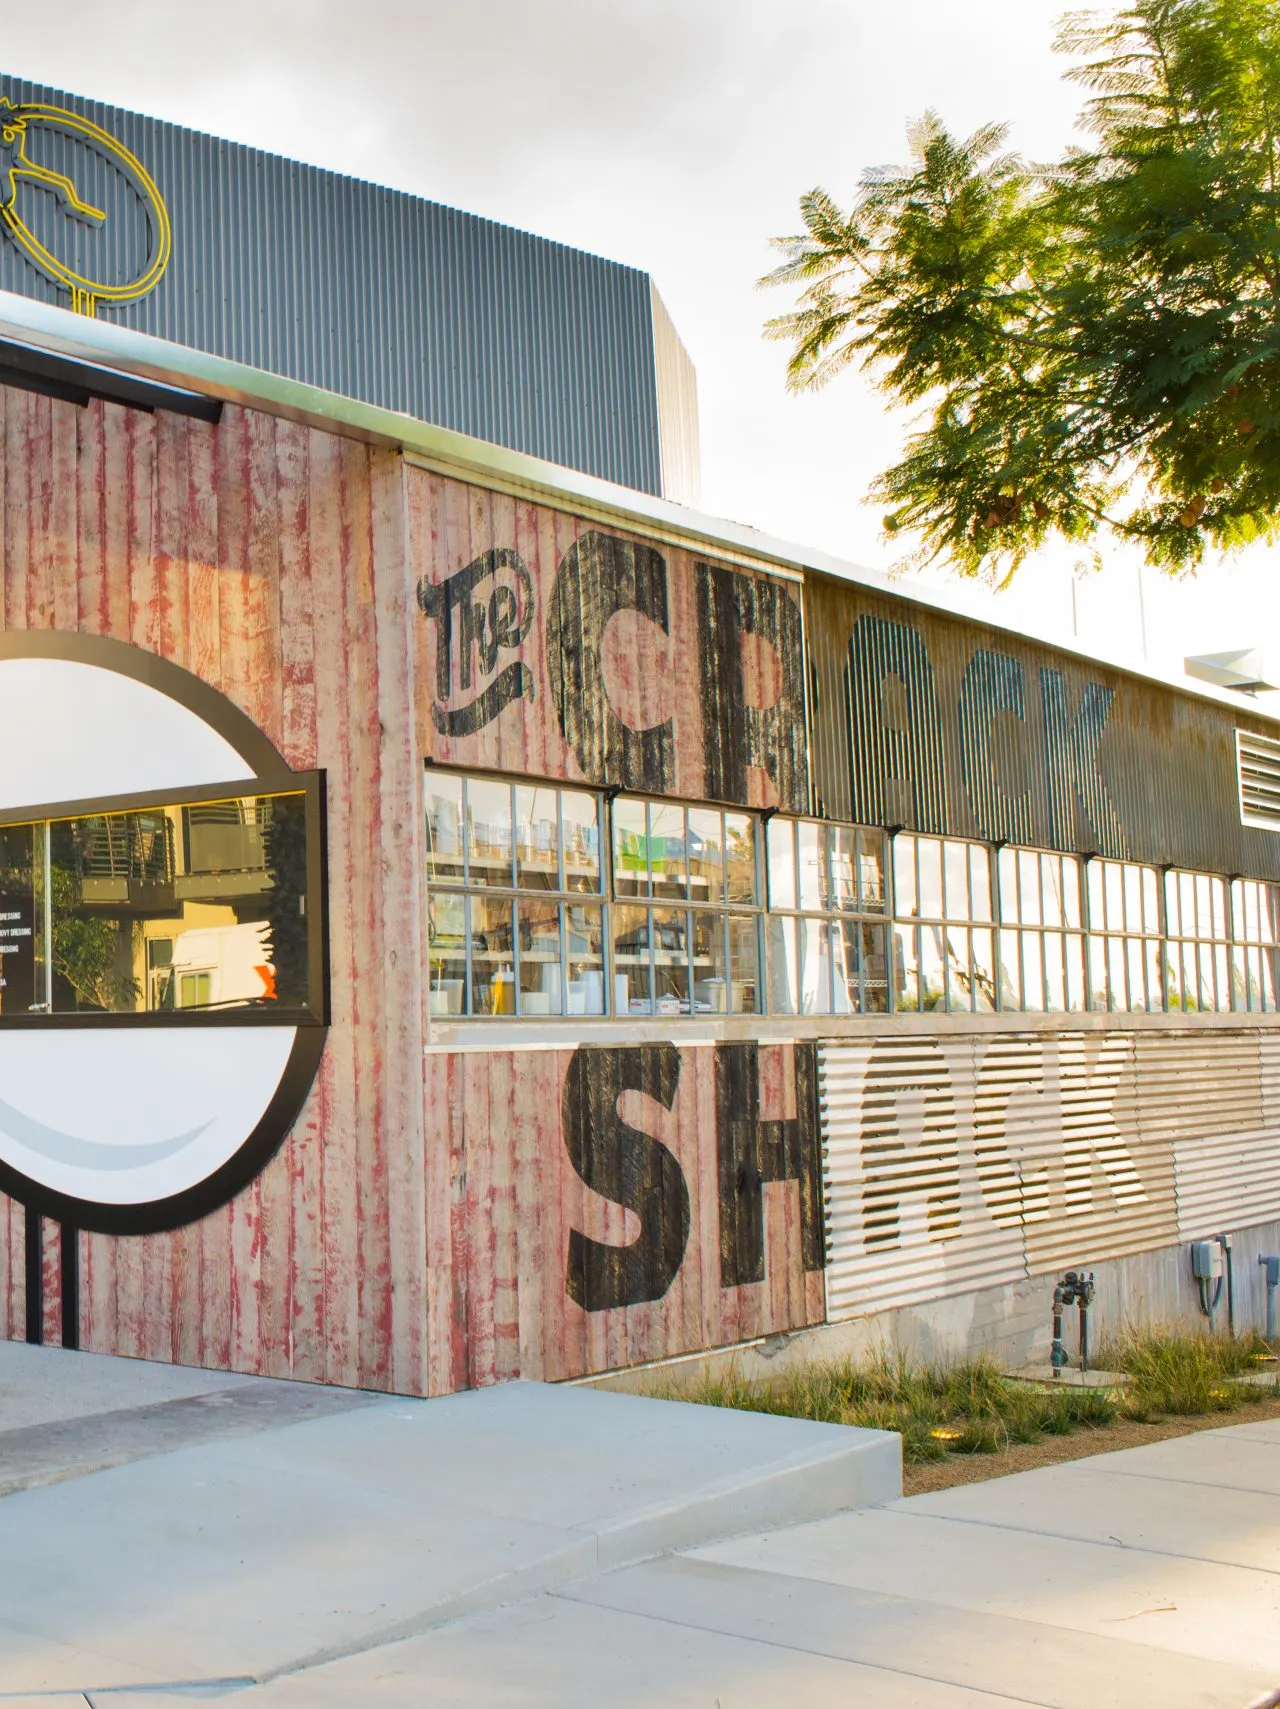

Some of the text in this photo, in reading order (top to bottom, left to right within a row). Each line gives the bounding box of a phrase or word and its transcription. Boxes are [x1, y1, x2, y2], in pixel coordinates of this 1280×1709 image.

[416, 530, 1129, 861] The CRACK
[561, 1033, 1151, 1313] SHACK
